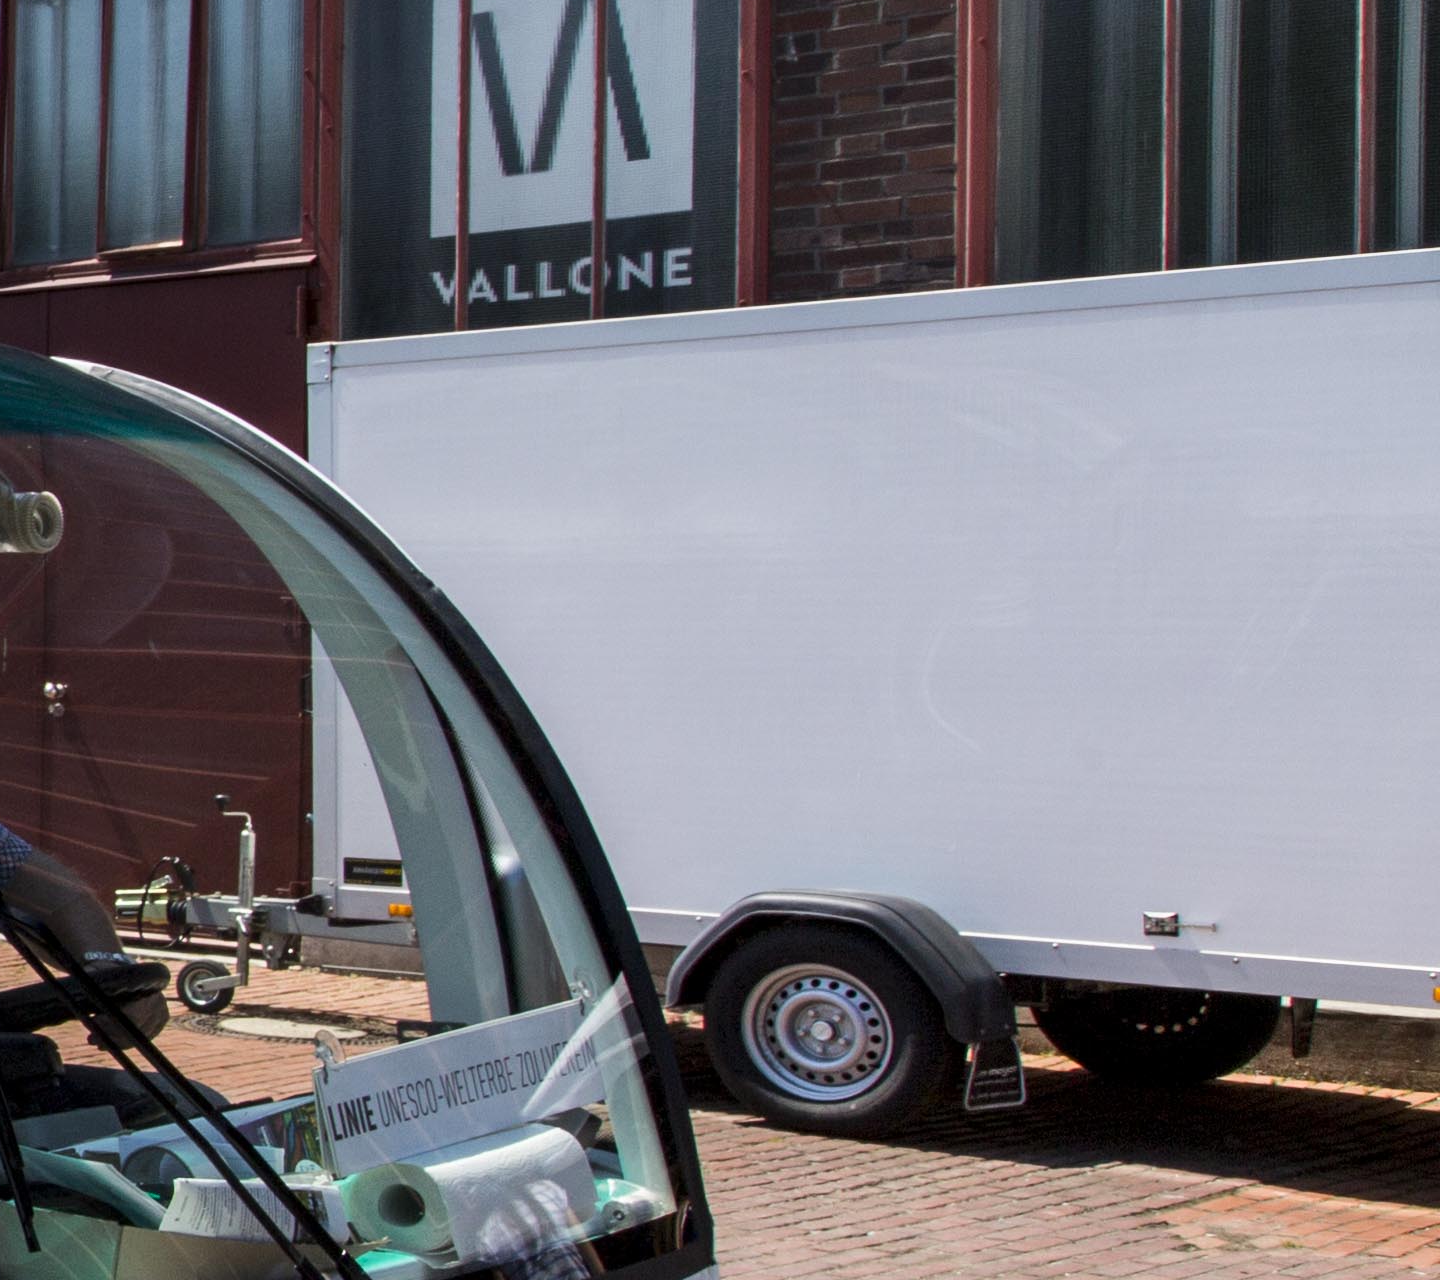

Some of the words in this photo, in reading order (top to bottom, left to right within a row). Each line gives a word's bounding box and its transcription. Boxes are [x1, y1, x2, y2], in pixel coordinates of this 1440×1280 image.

[429, 247, 694, 307] VALLONE
[327, 1092, 379, 1143] LINIE
[379, 1056, 517, 1131] UNESCO-WELTERBE
[515, 1034, 599, 1090] ZOLLVEREIN
